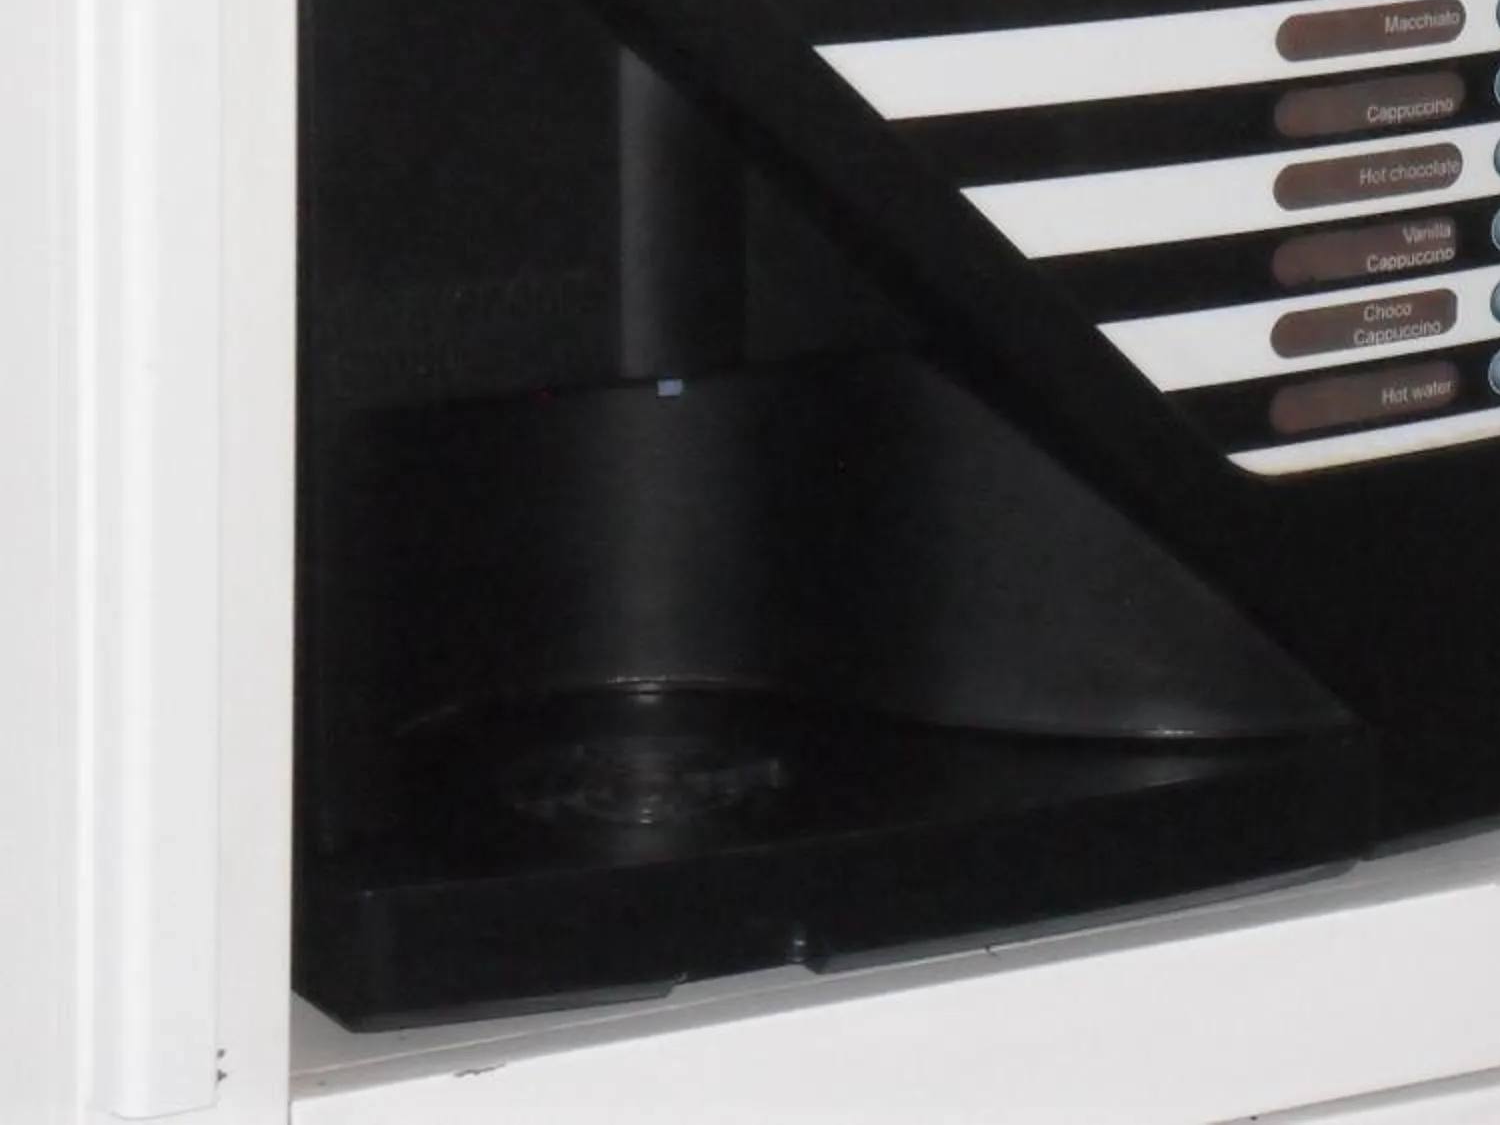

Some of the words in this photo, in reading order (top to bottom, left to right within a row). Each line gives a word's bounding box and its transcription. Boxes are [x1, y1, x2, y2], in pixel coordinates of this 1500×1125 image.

[1384, 11, 1460, 34] Macchiato
[1366, 97, 1454, 124] Cappuccino
[1360, 167, 1387, 186] Hot
[1389, 159, 1460, 182] chocolate
[1402, 222, 1451, 244] Vanilla
[1366, 247, 1454, 273] Cappuccino
[1363, 302, 1413, 322] Choco
[1353, 320, 1441, 346] Cappuccino
[1381, 386, 1408, 406] Hot
[1412, 380, 1452, 400] water
